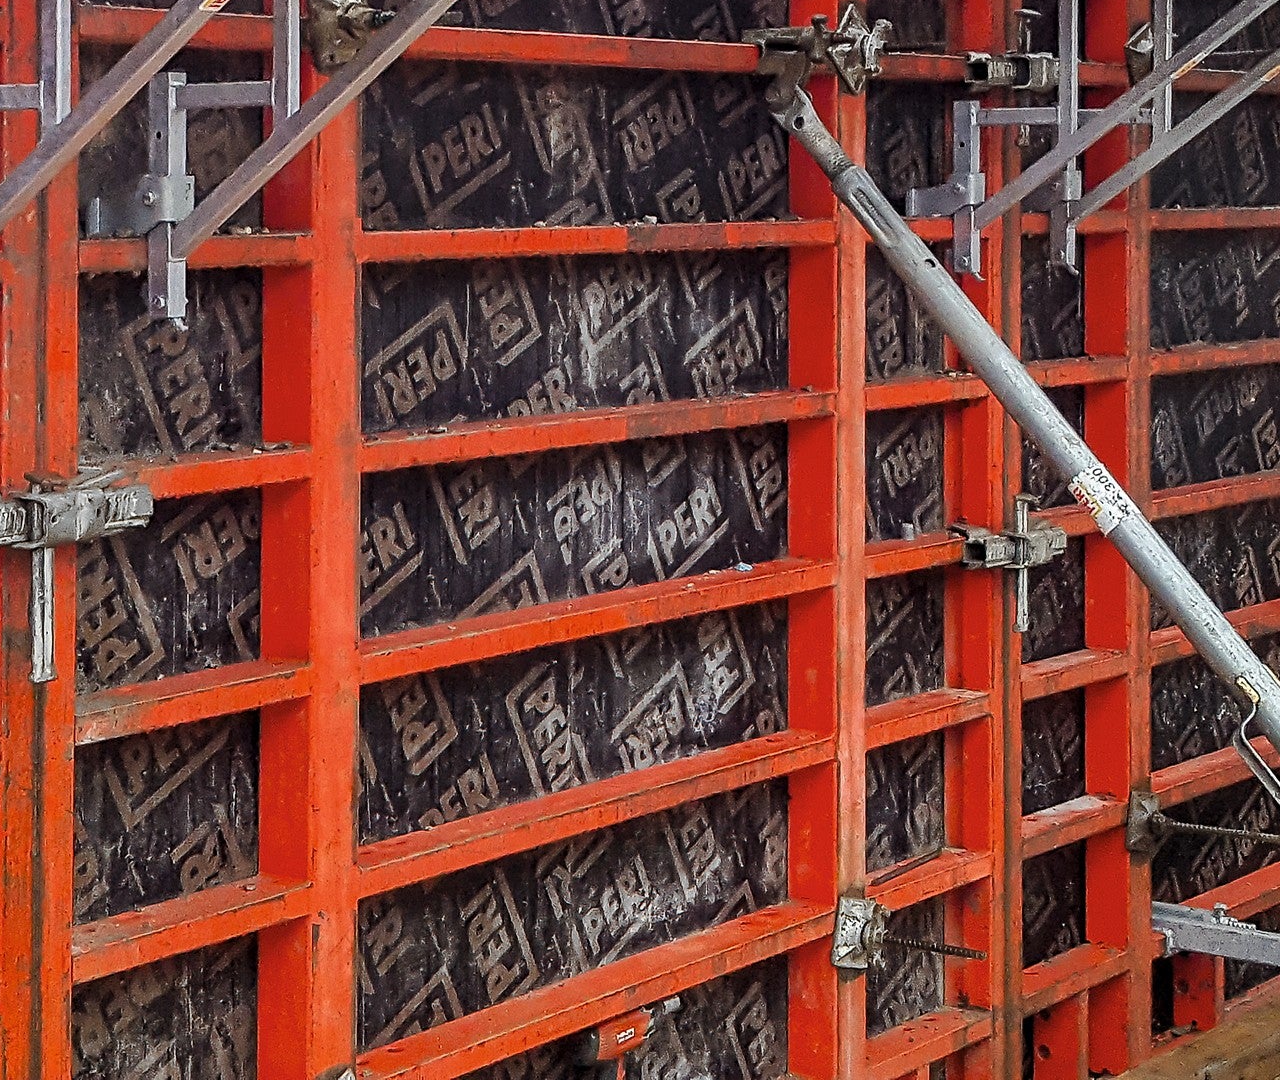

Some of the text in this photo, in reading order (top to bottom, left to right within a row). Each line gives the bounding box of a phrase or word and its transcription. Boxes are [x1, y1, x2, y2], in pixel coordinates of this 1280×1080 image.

[421, 102, 502, 194] PERI
[620, 88, 687, 173] PERI
[144, 322, 220, 451] PERI
[374, 328, 458, 427] PERI
[657, 473, 723, 566] PERI
[1092, 468, 1115, 492] 300
[361, 502, 416, 587] ERI
